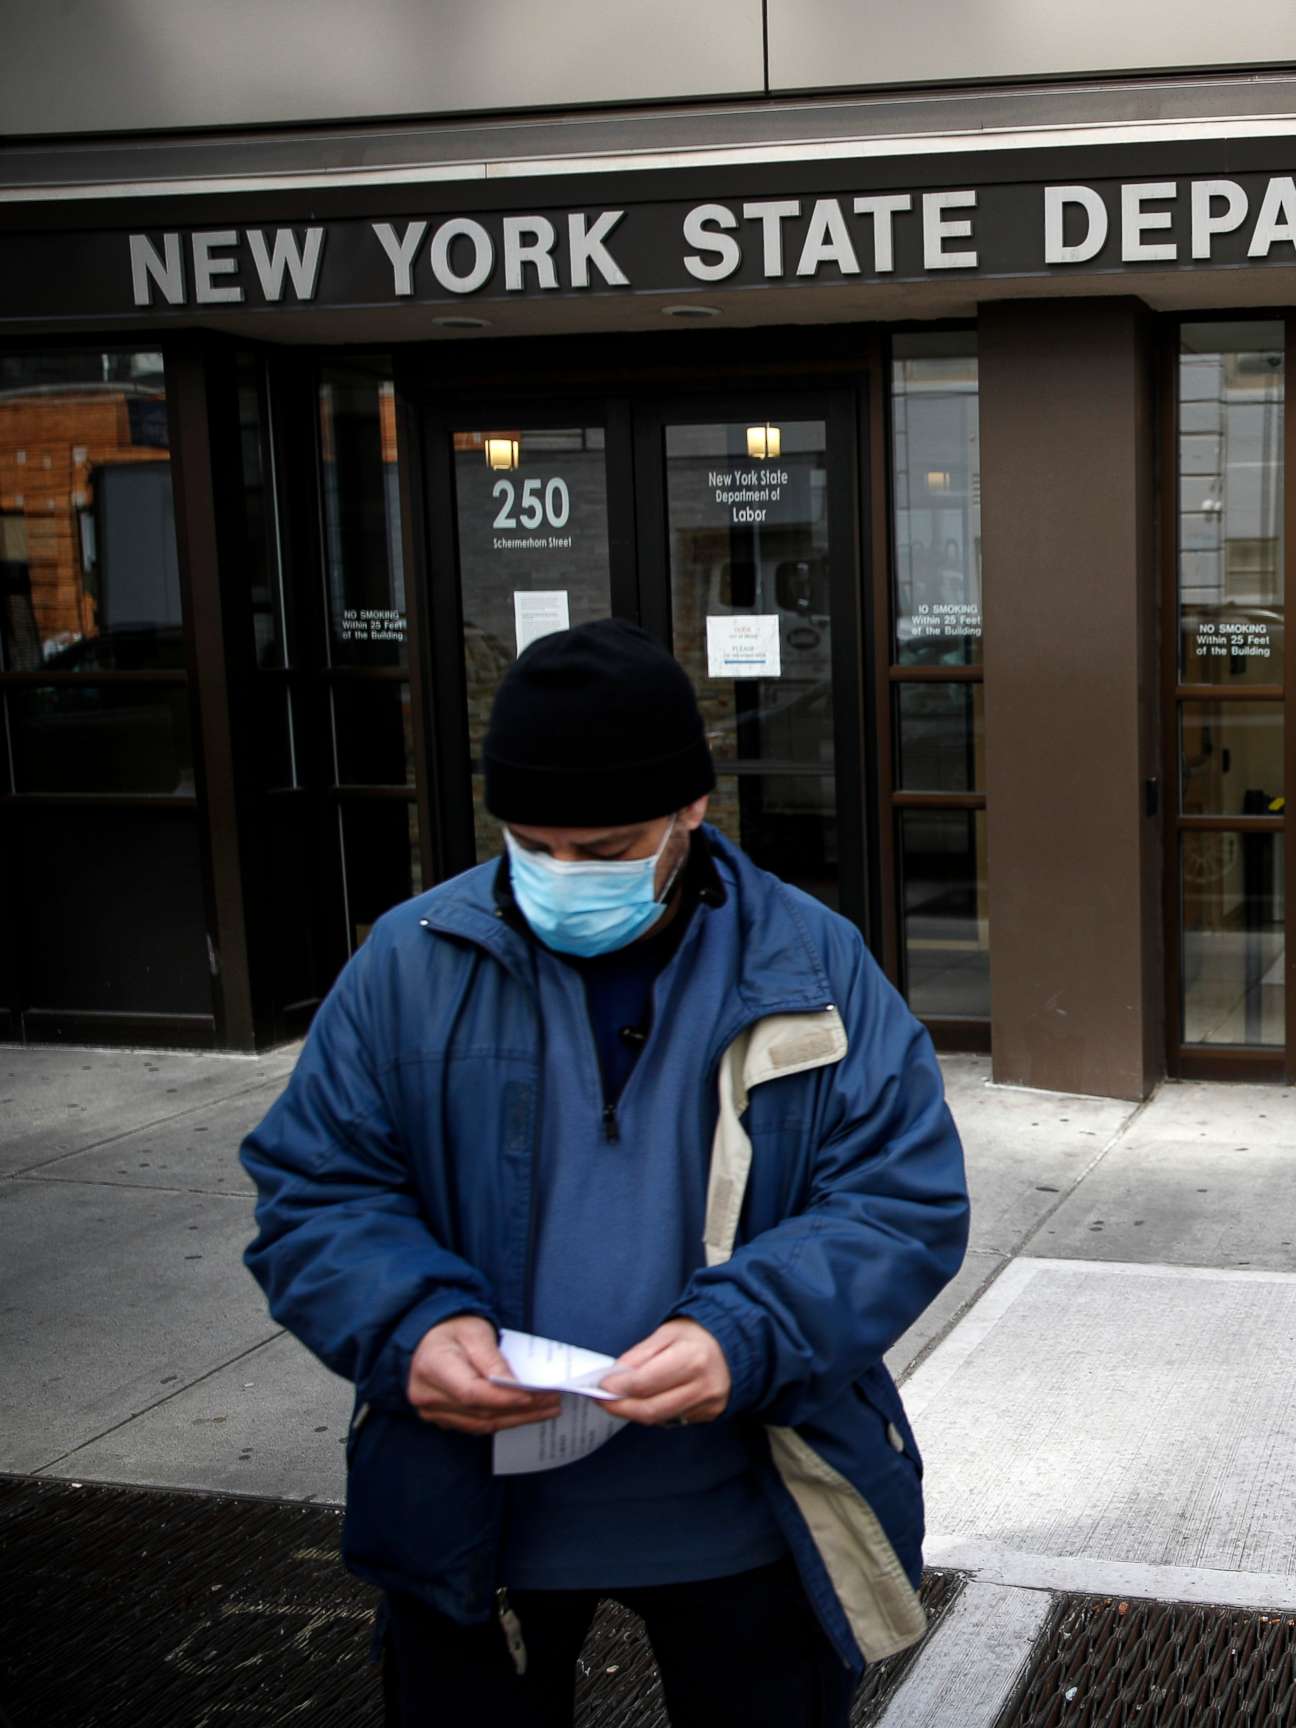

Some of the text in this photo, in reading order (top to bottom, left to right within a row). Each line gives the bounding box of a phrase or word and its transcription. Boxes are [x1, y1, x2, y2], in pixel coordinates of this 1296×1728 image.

[130, 228, 323, 304] NEW
[372, 211, 629, 295] YORK
[683, 190, 978, 280] STATE
[708, 468, 788, 487] New York State
[715, 487, 780, 505] Department of
[492, 476, 570, 529] 250
[732, 506, 767, 522] Labor
[493, 536, 572, 549] Schermerhorn Street
[343, 609, 399, 620] NO SMOKING
[933, 604, 978, 614] SMOKING
[342, 619, 403, 630] Within 25 Feet
[911, 615, 981, 625] Within 25 Feet
[911, 626, 982, 637] of the Building
[1199, 624, 1267, 634] NO SMOKING
[342, 630, 403, 642] of the Building
[1196, 635, 1270, 644] Within 25 Feet
[1196, 646, 1271, 658] of the Building
